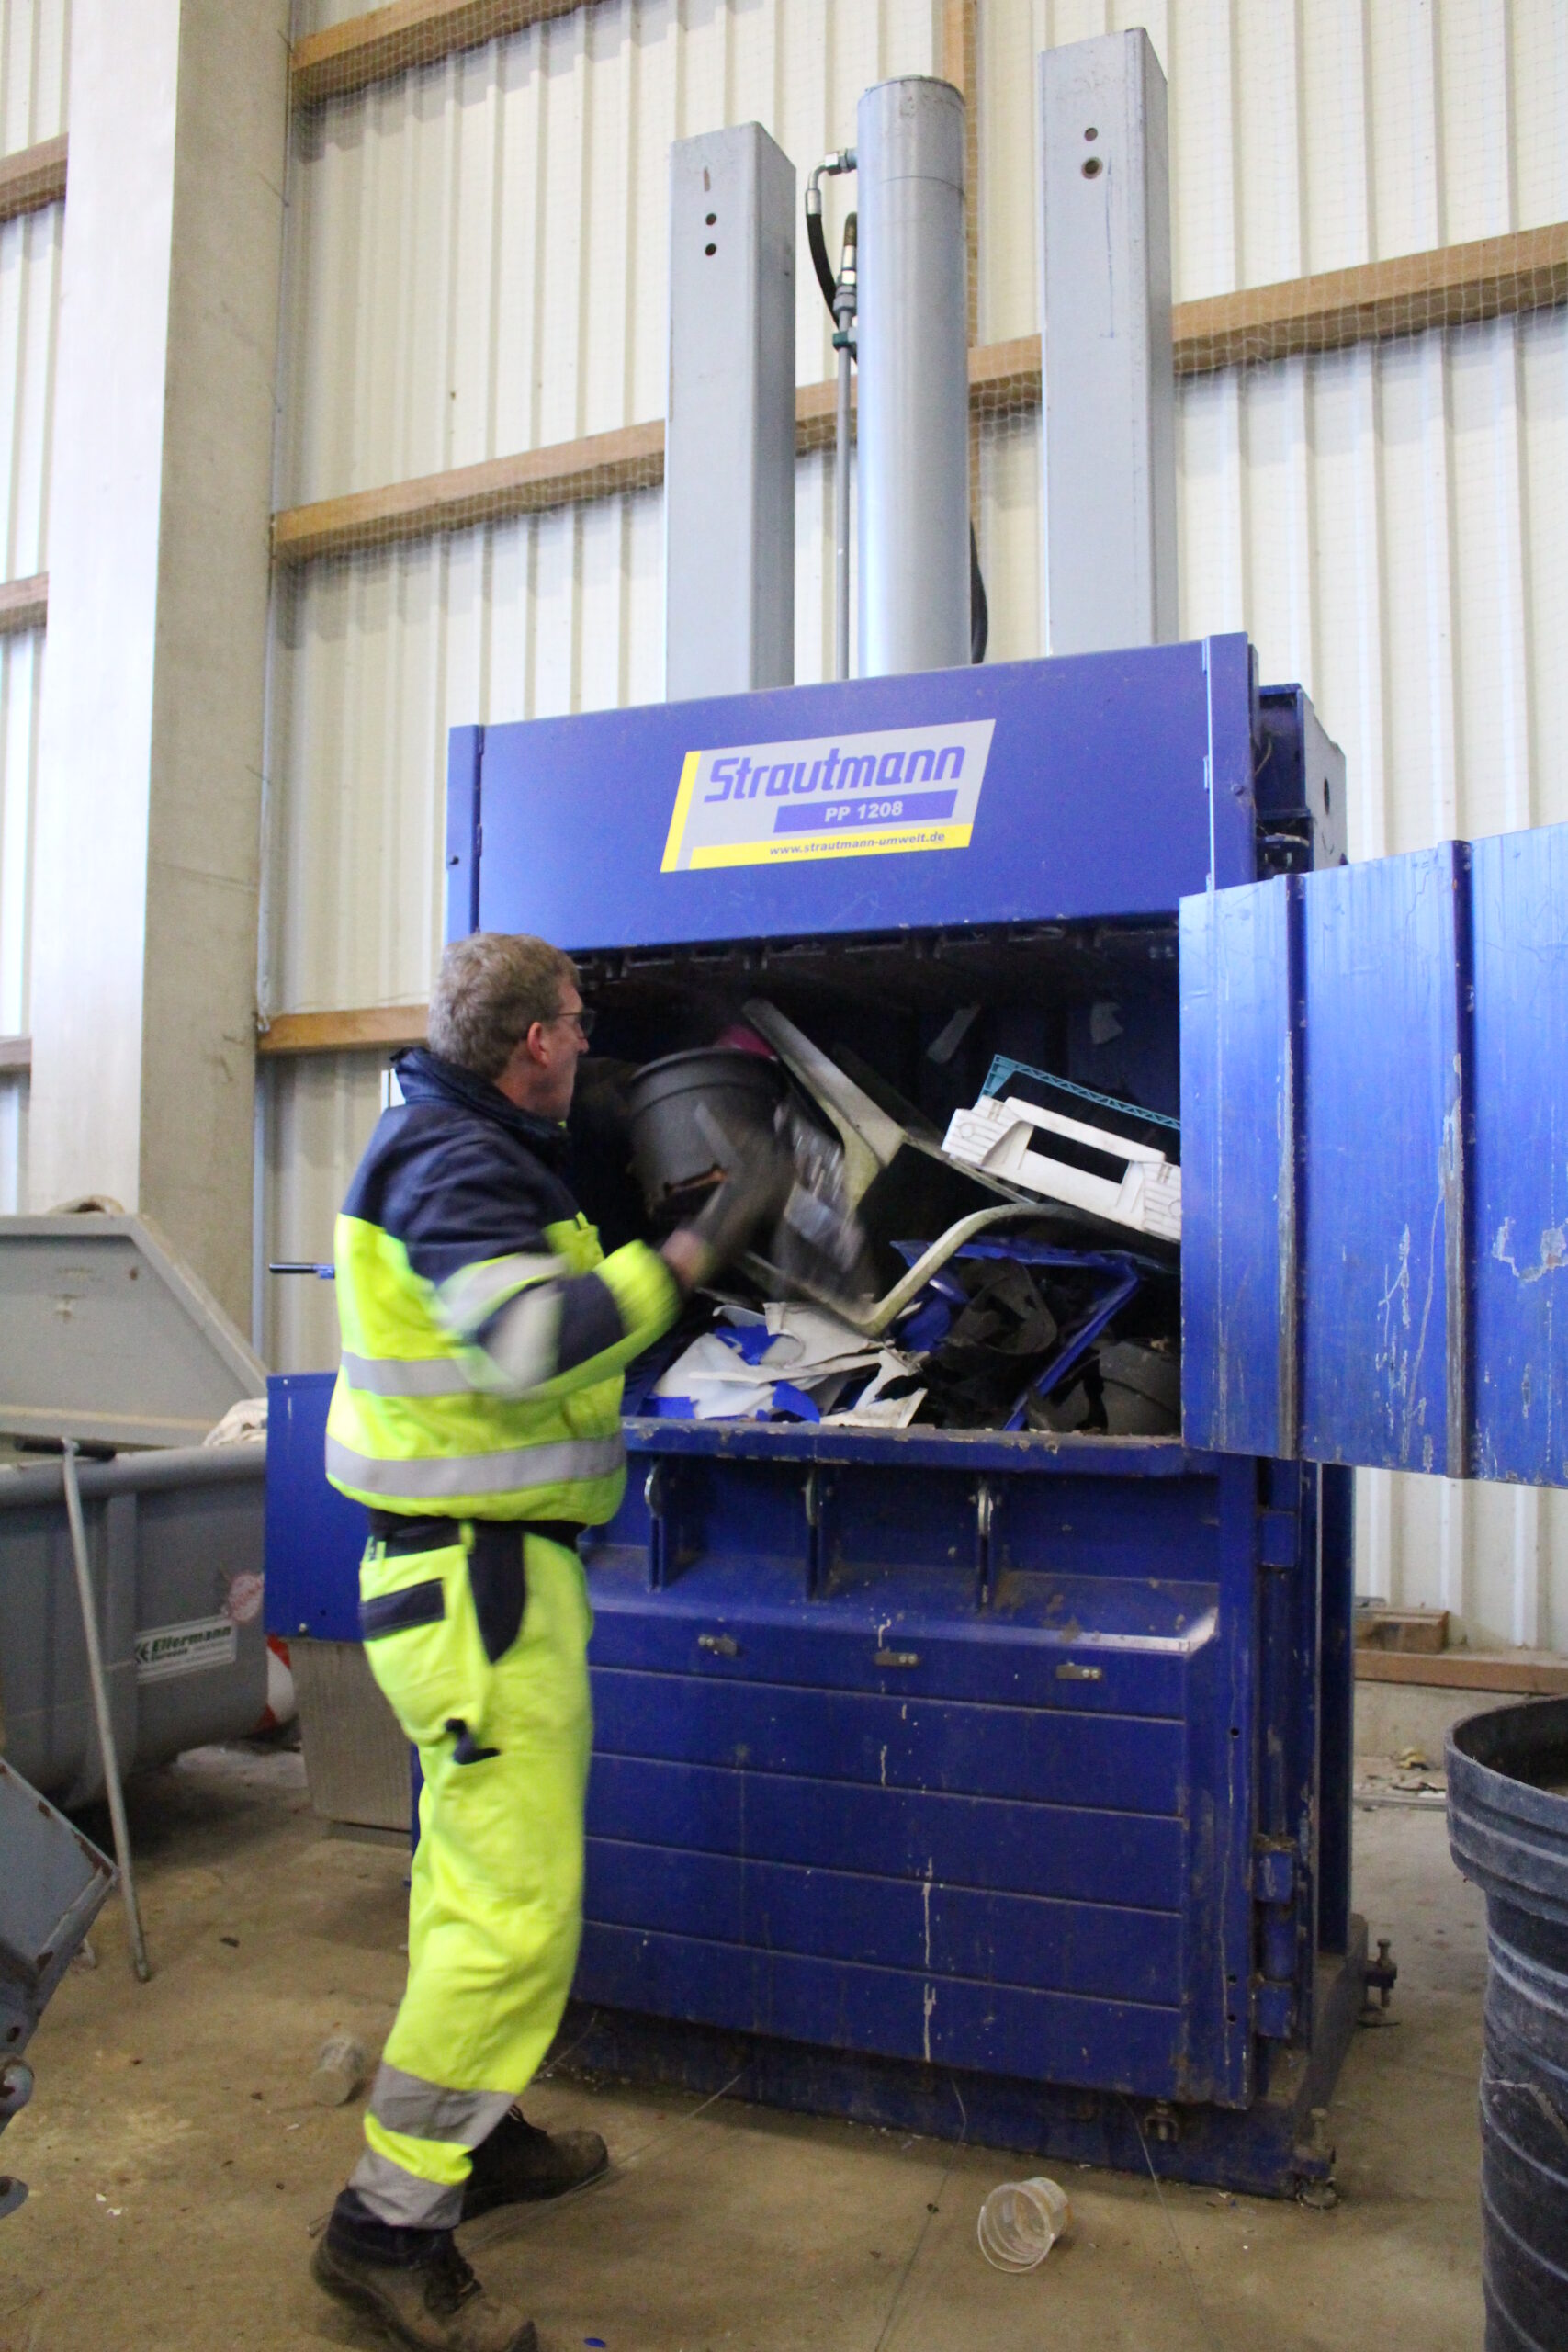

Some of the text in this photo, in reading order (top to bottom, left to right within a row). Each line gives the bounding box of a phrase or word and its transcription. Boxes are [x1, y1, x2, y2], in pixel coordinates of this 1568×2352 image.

[704, 746, 966, 803] Strautmann
[824, 800, 904, 822] PP 1208
[769, 831, 945, 855] www.strautmann-umwelt.de
